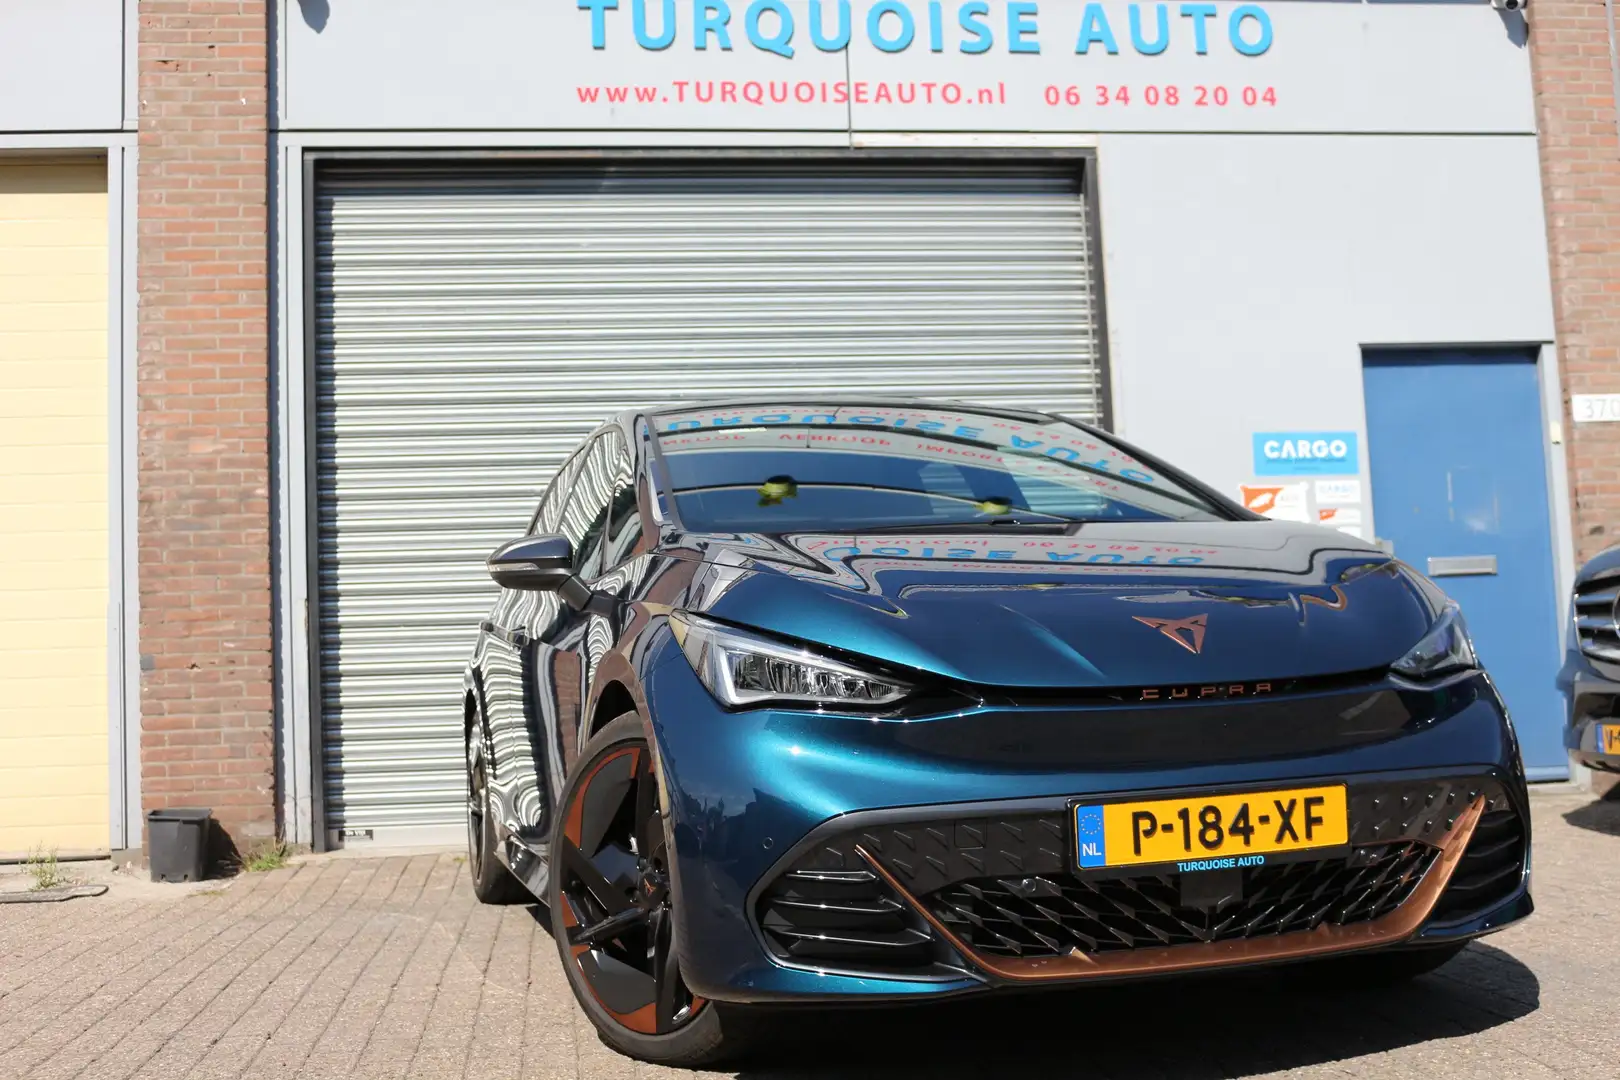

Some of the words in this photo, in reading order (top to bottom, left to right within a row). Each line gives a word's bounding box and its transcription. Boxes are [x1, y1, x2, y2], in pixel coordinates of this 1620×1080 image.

[577, 0, 1041, 59] TURQUOISE
[1074, 2, 1274, 57] AUTO
[577, 81, 1006, 105] www.TURQUOISEAUTO.nl
[1044, 86, 1081, 106] 06
[1095, 86, 1130, 106] 34
[1144, 86, 1180, 106] 08
[1194, 86, 1228, 106] 20
[1242, 87, 1277, 106] 04
[1264, 439, 1347, 459] CARGO
[1142, 682, 1273, 699] CUPRA
[1082, 843, 1102, 857] NL
[1131, 795, 1325, 857] P-184-XF
[1177, 858, 1236, 872] TURQUOISE
[1238, 855, 1265, 867] AUTO
